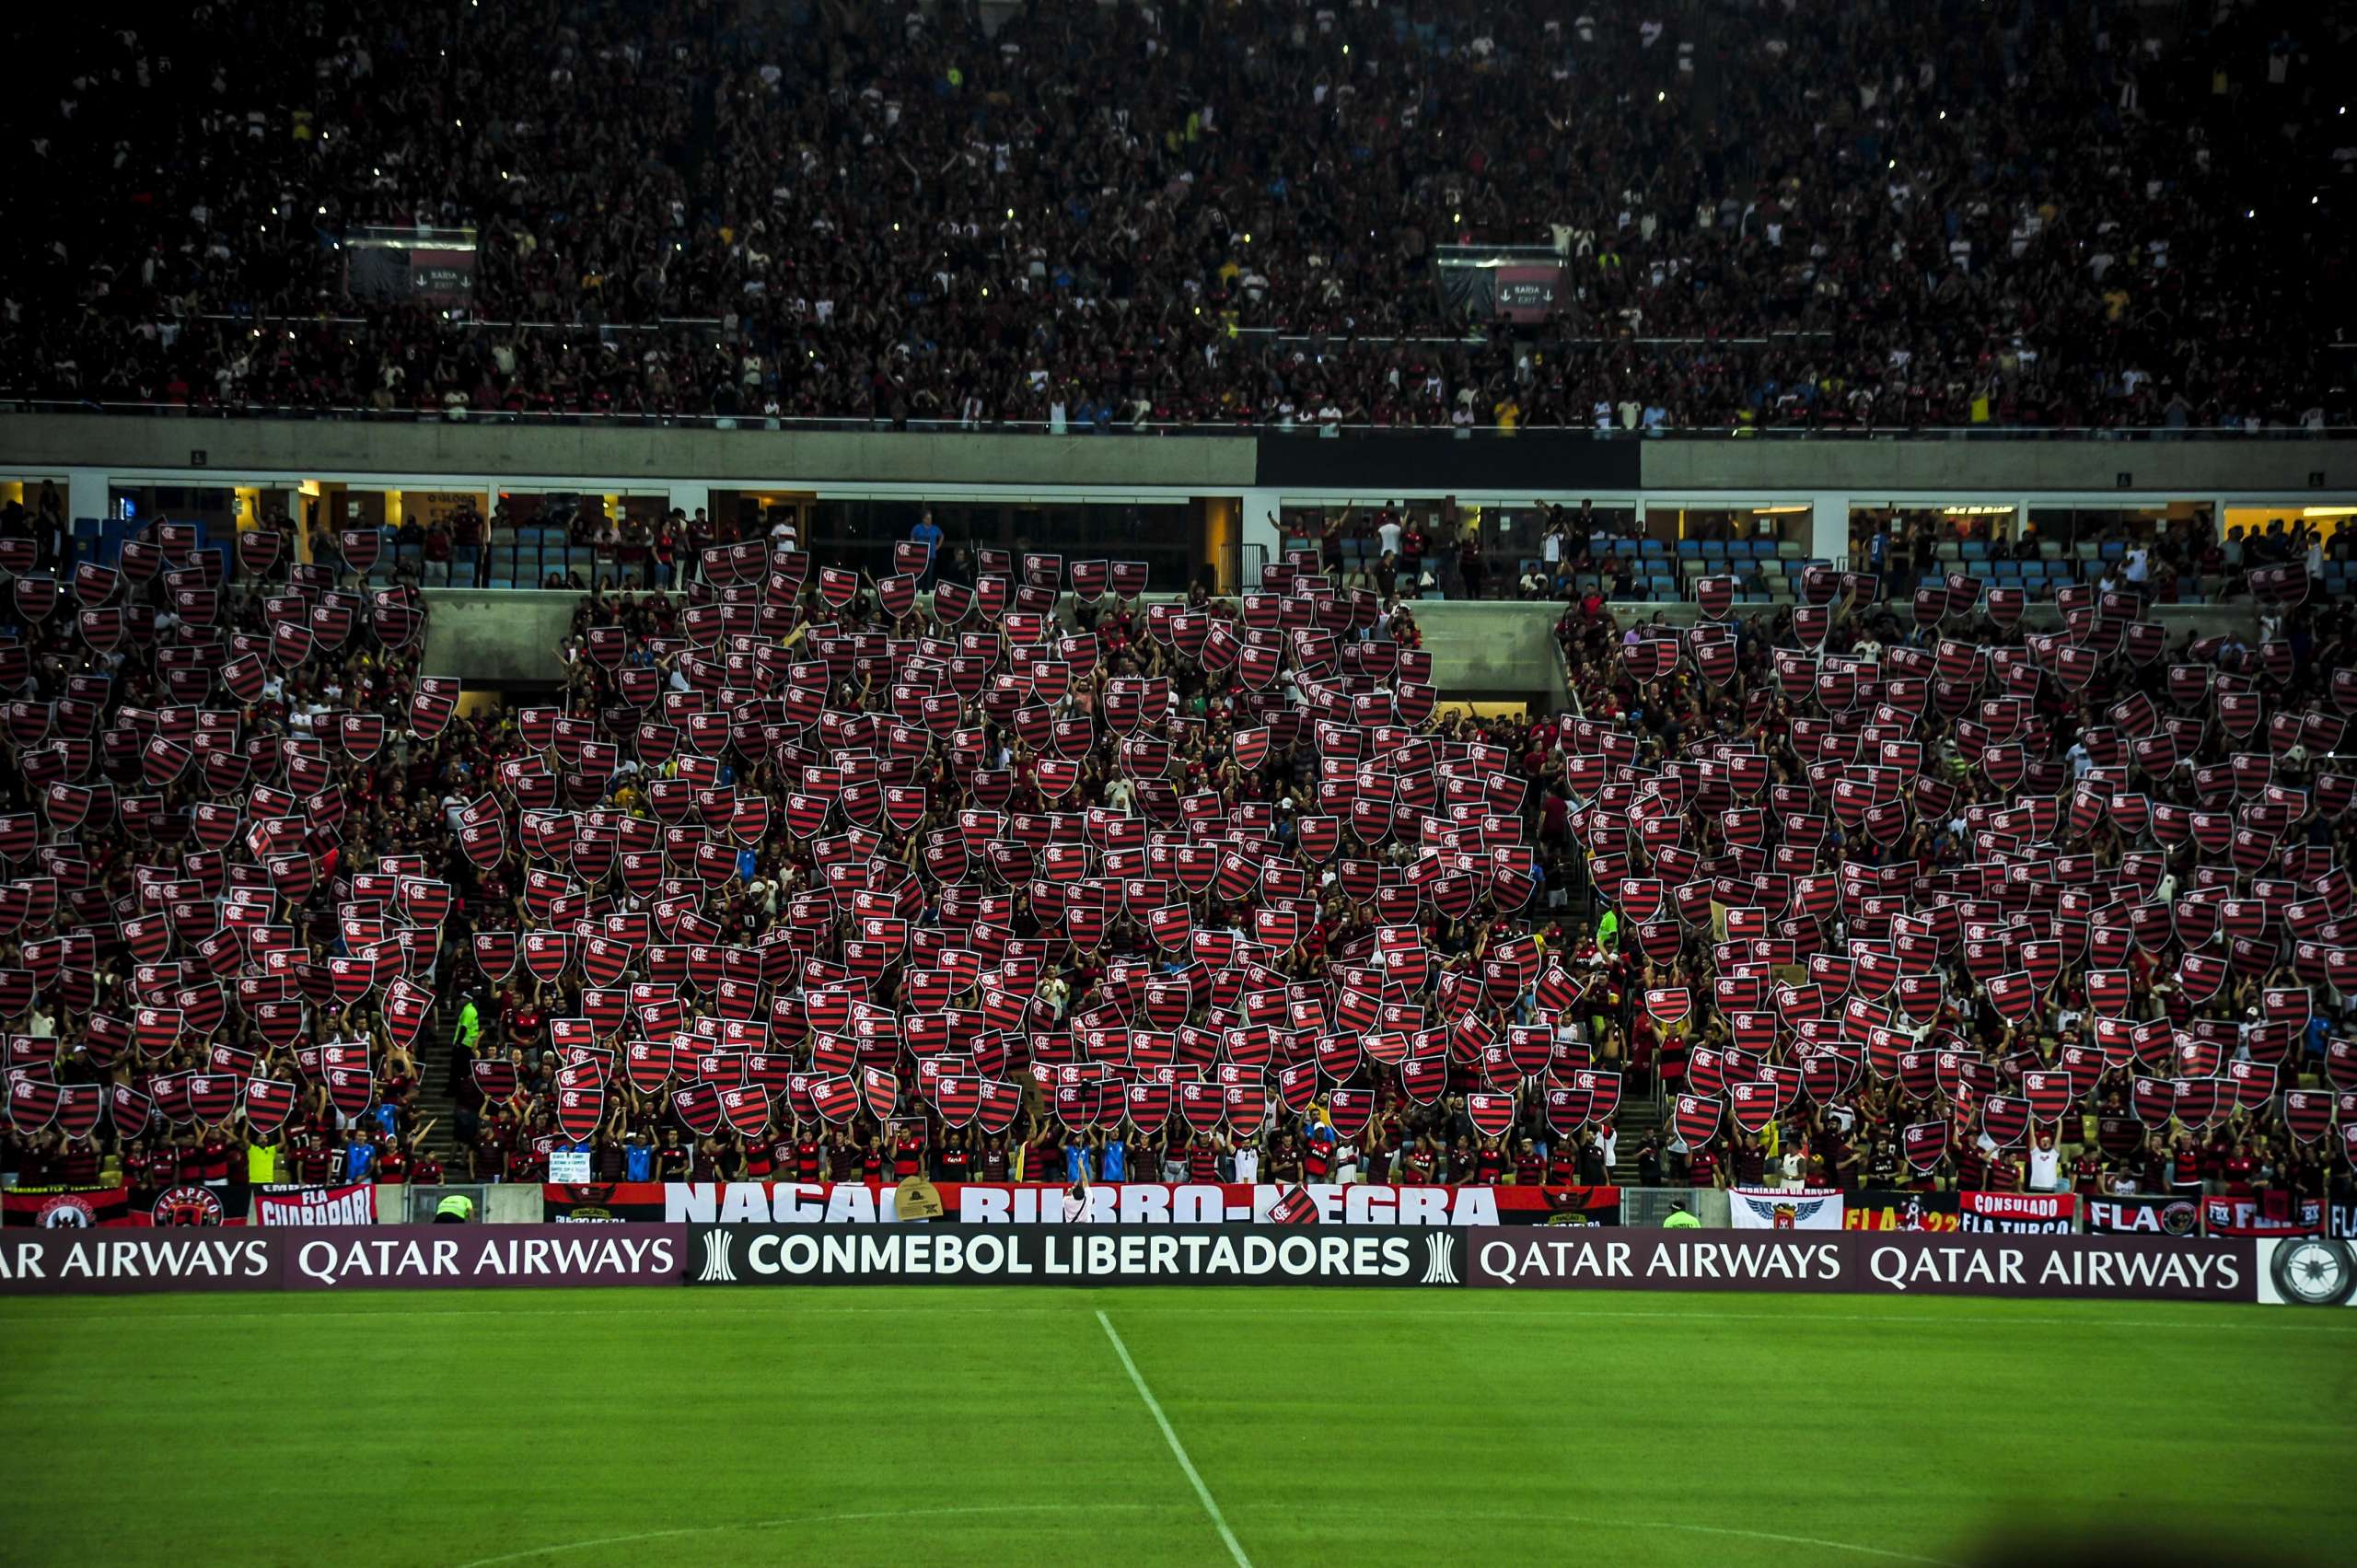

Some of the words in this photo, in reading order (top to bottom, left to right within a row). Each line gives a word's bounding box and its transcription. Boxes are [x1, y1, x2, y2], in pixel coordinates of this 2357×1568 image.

[302, 1190, 328, 1205] FLA
[1974, 1194, 2059, 1217] CONSULADO
[1963, 1212, 1994, 1234] FLA
[2090, 1202, 2161, 1232] FLA
[60, 1240, 268, 1278] AIRWAYS
[299, 1240, 460, 1285] QATAR
[473, 1238, 674, 1275] AIRWAYS
[748, 1235, 1032, 1274] CONMEBOL
[1045, 1236, 1411, 1277] LIBERTADORES
[1480, 1241, 1633, 1284] QATAR
[1646, 1243, 1840, 1280] AIRWAYS
[1870, 1247, 2026, 1291] QATAR
[2039, 1250, 2239, 1290] AIRWAYS
